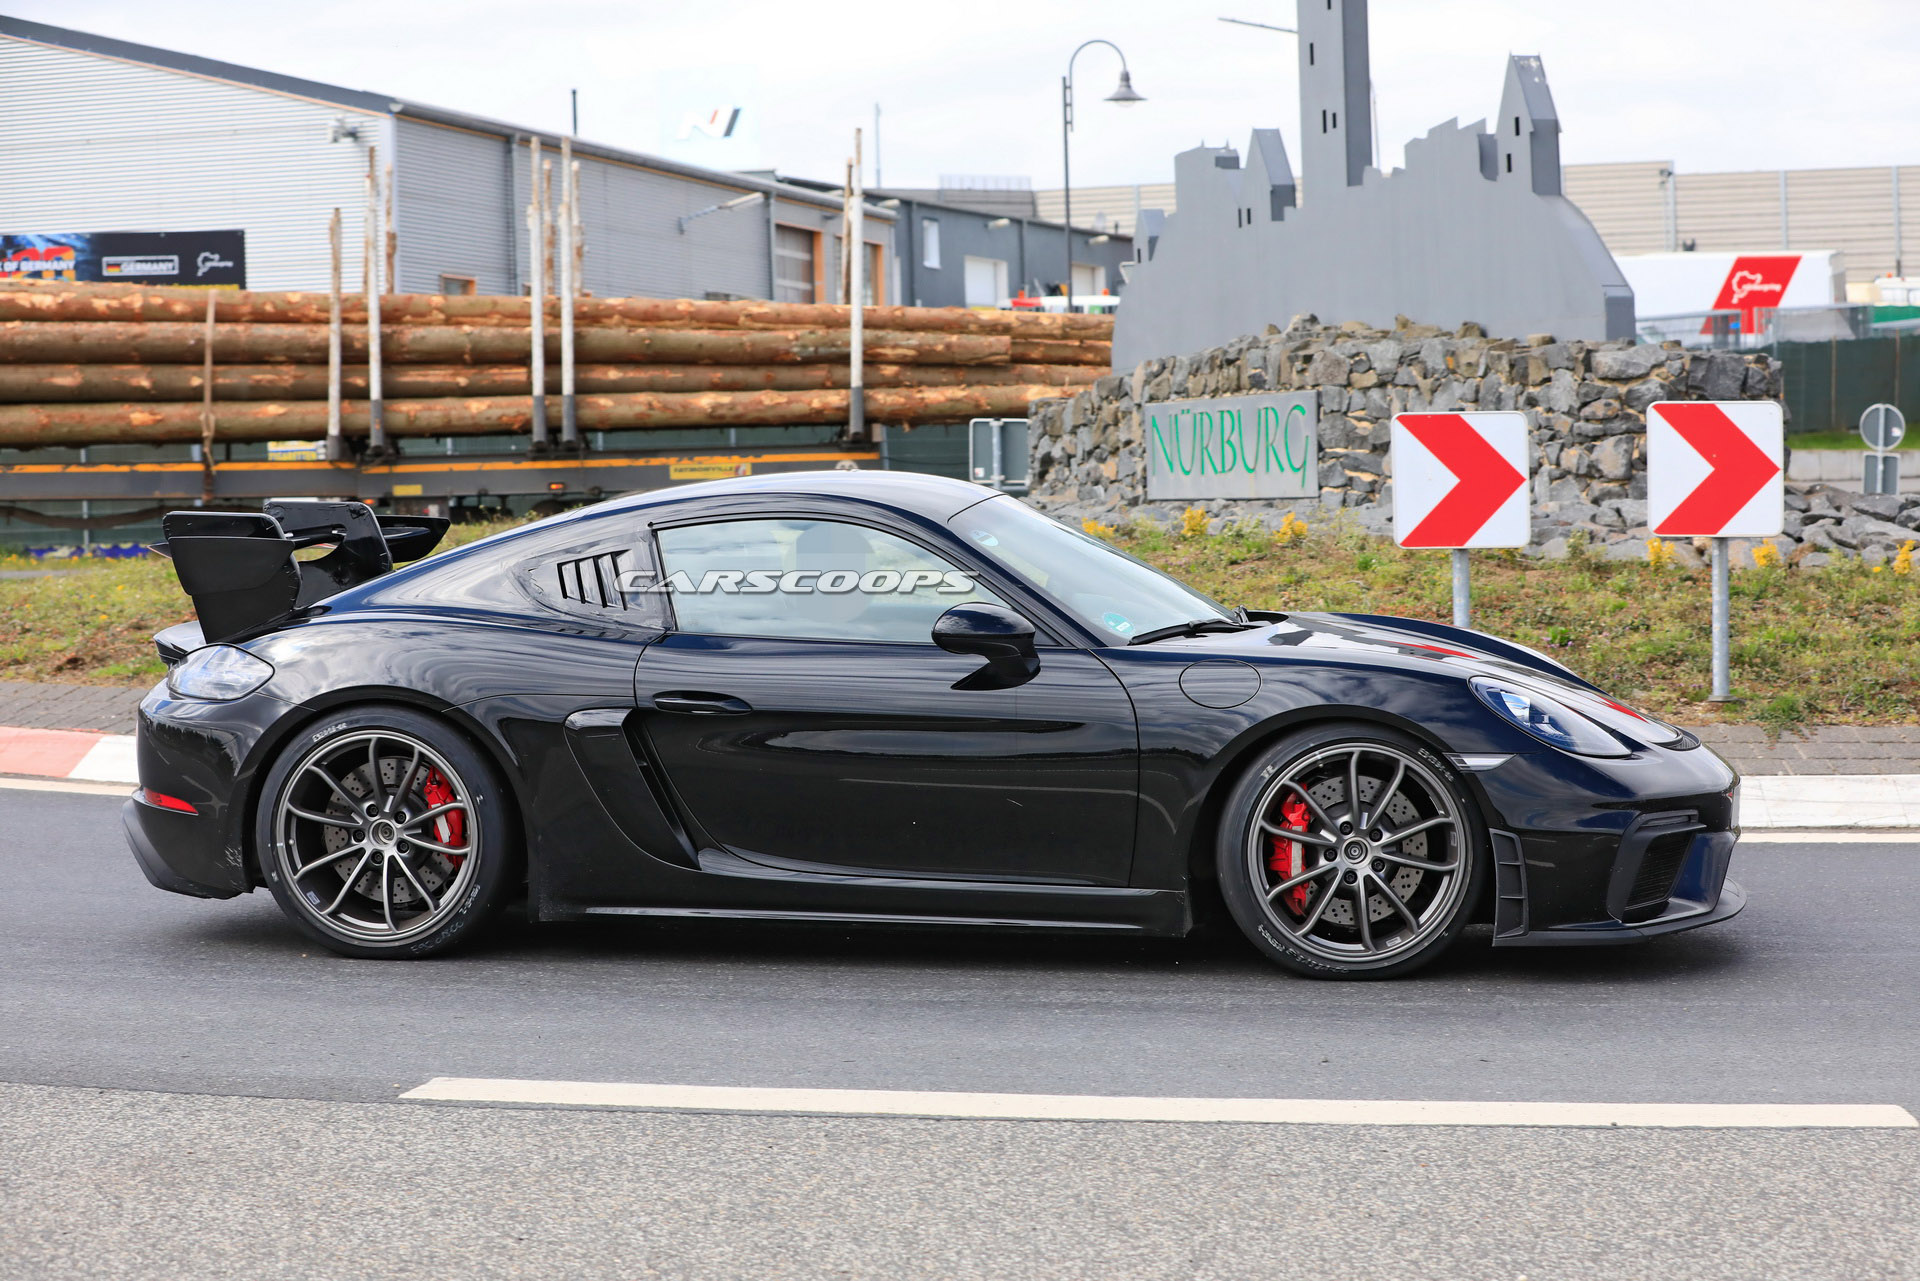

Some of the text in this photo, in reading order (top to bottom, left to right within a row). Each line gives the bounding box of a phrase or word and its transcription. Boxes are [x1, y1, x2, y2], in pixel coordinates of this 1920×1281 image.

[20, 259, 76, 272] GERMANY
[121, 261, 175, 272] GERMANY
[1151, 404, 1309, 489] NÜRBURG
